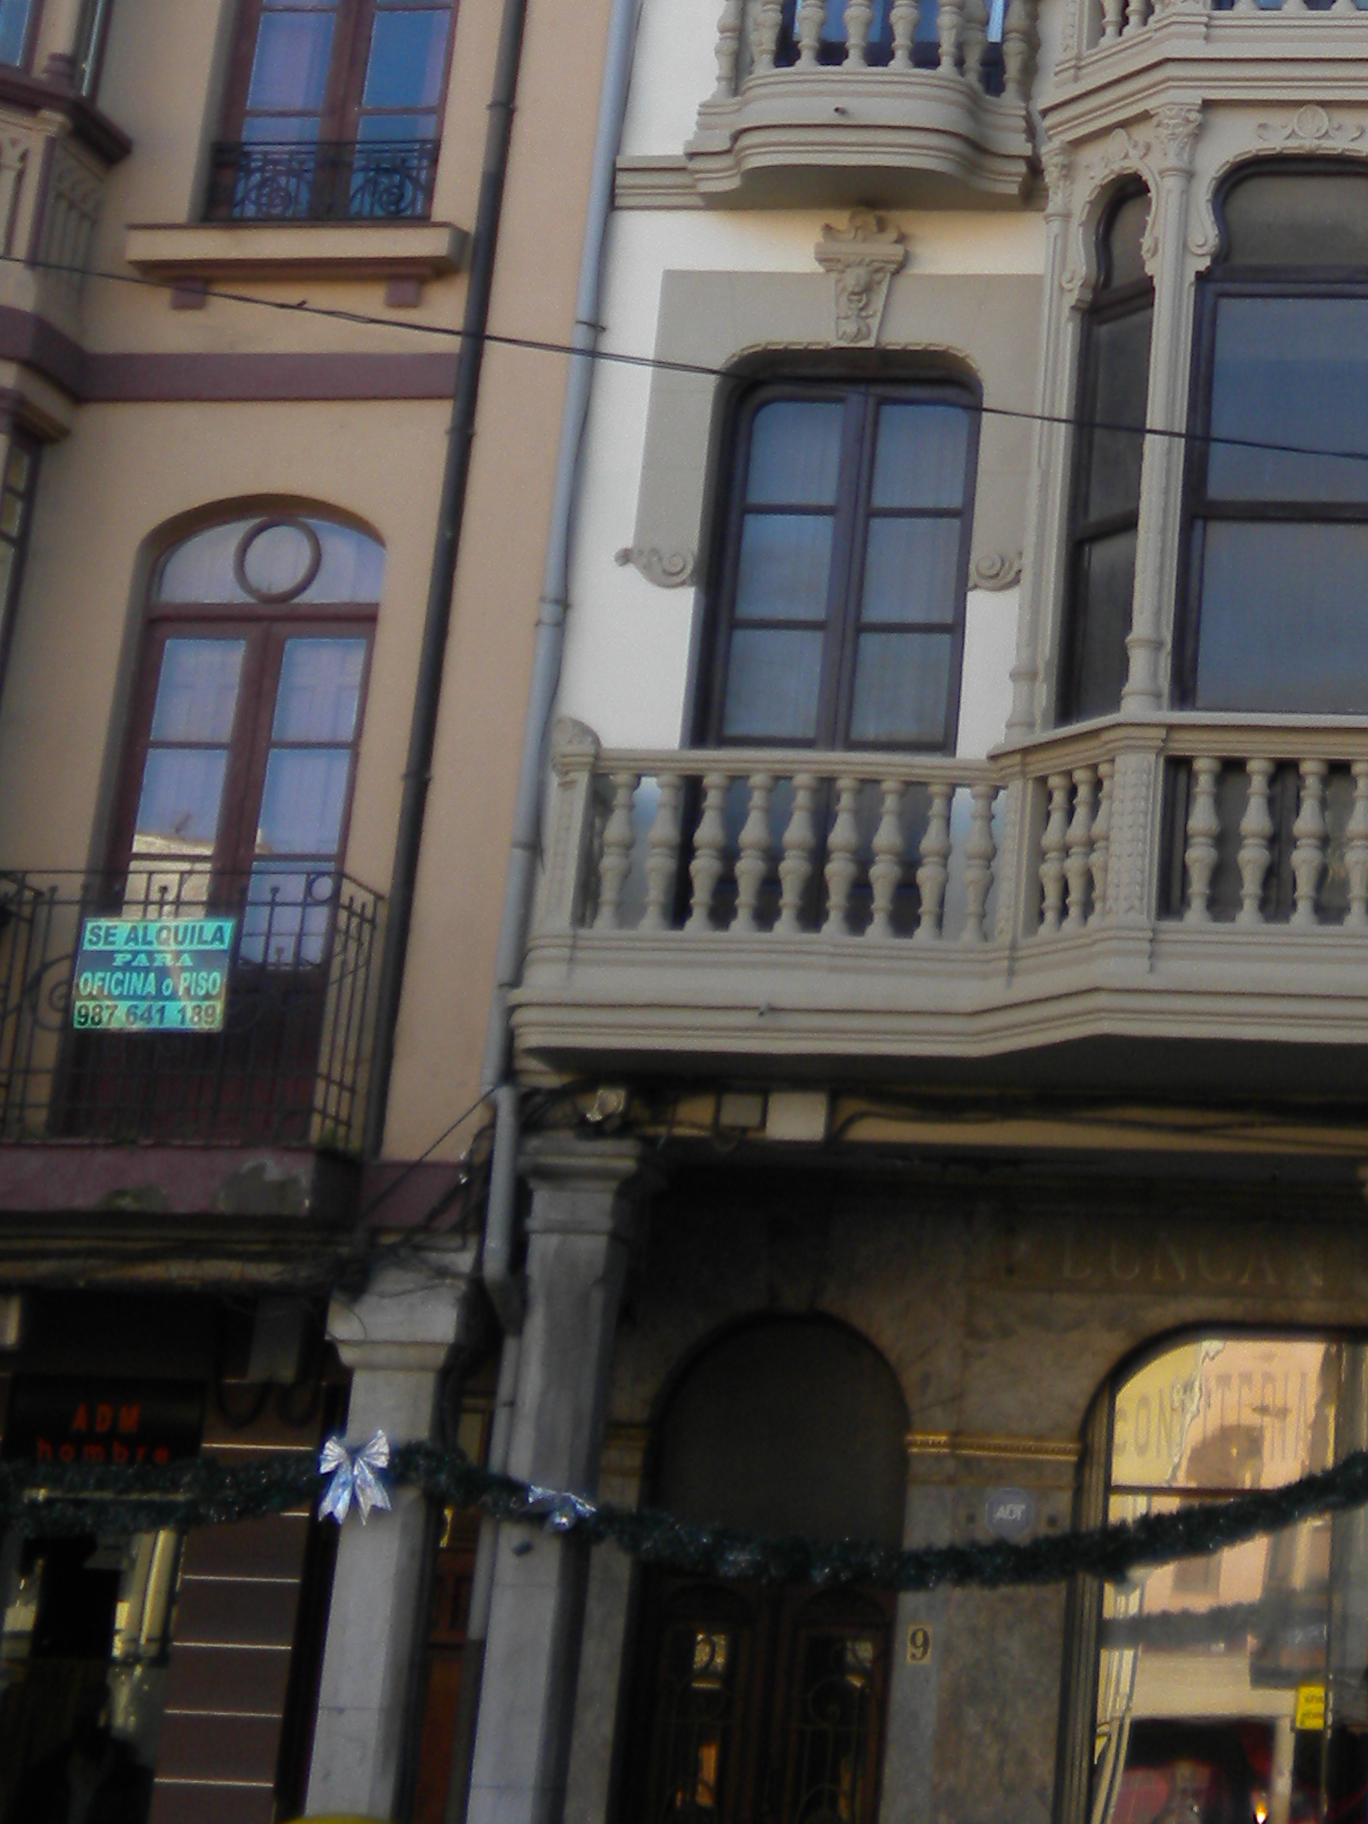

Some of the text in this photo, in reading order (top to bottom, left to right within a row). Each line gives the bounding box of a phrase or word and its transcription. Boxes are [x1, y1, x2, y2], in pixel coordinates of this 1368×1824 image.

[88, 923, 226, 947] SE ALQUILA
[112, 952, 193, 967] PARA
[78, 971, 156, 996] OFICINA
[178, 972, 221, 996] PISO
[77, 1003, 217, 1026] 987 641 189
[70, 1403, 142, 1433] ADM
[35, 1437, 169, 1465] hombre
[994, 1504, 1026, 1522] ADT
[909, 1628, 930, 1662] 9
